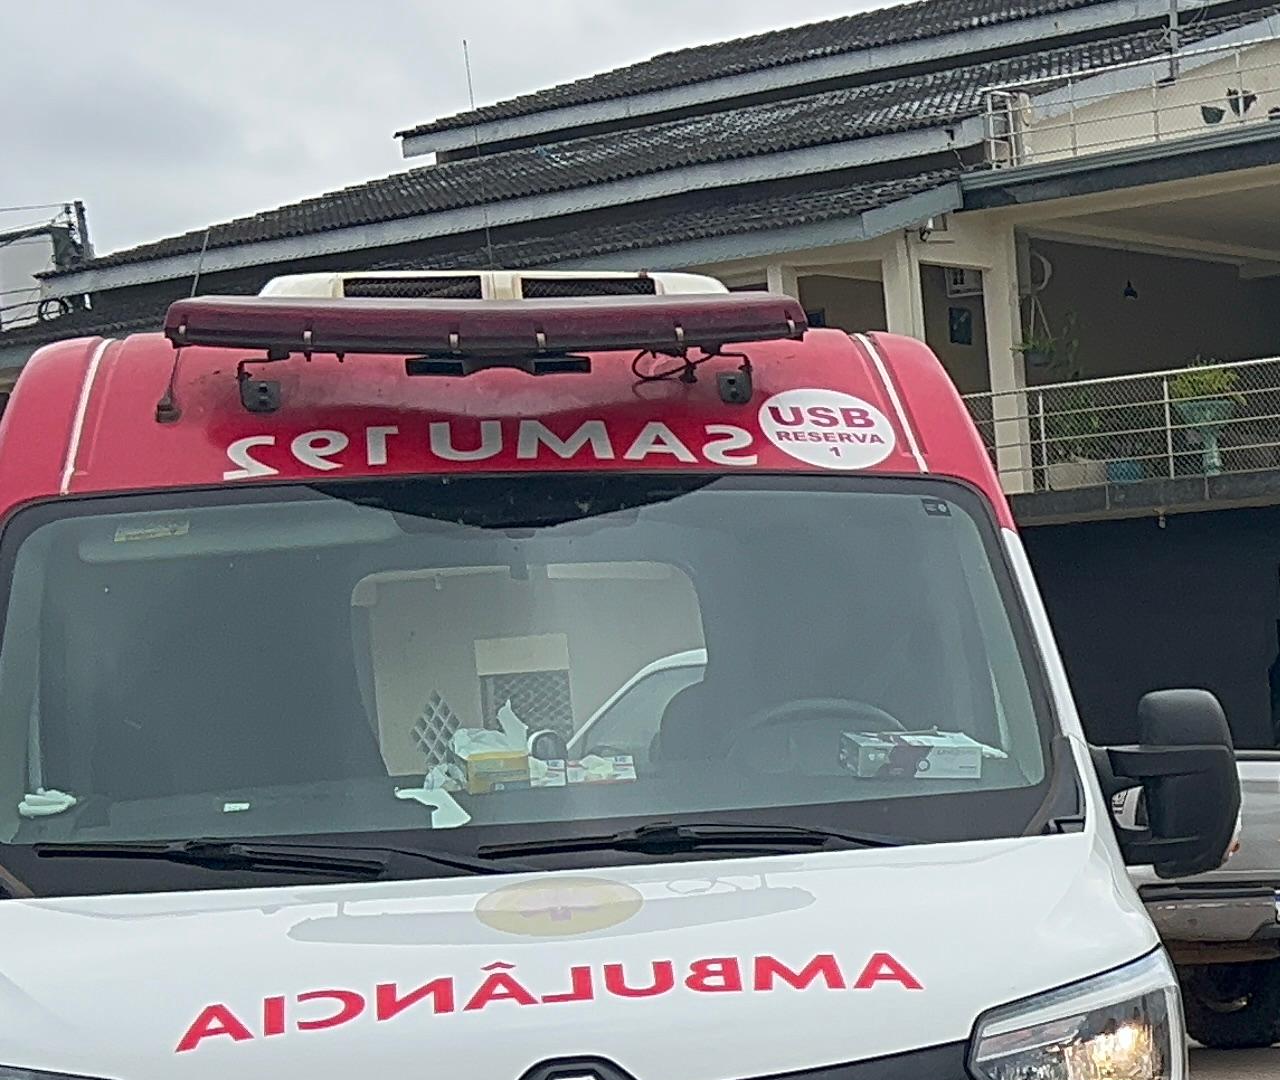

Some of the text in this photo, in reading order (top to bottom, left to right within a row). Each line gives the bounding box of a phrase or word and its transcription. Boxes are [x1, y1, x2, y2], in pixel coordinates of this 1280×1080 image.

[767, 406, 875, 428] USB
[776, 431, 885, 444] RESERVA
[829, 446, 841, 457] 1
